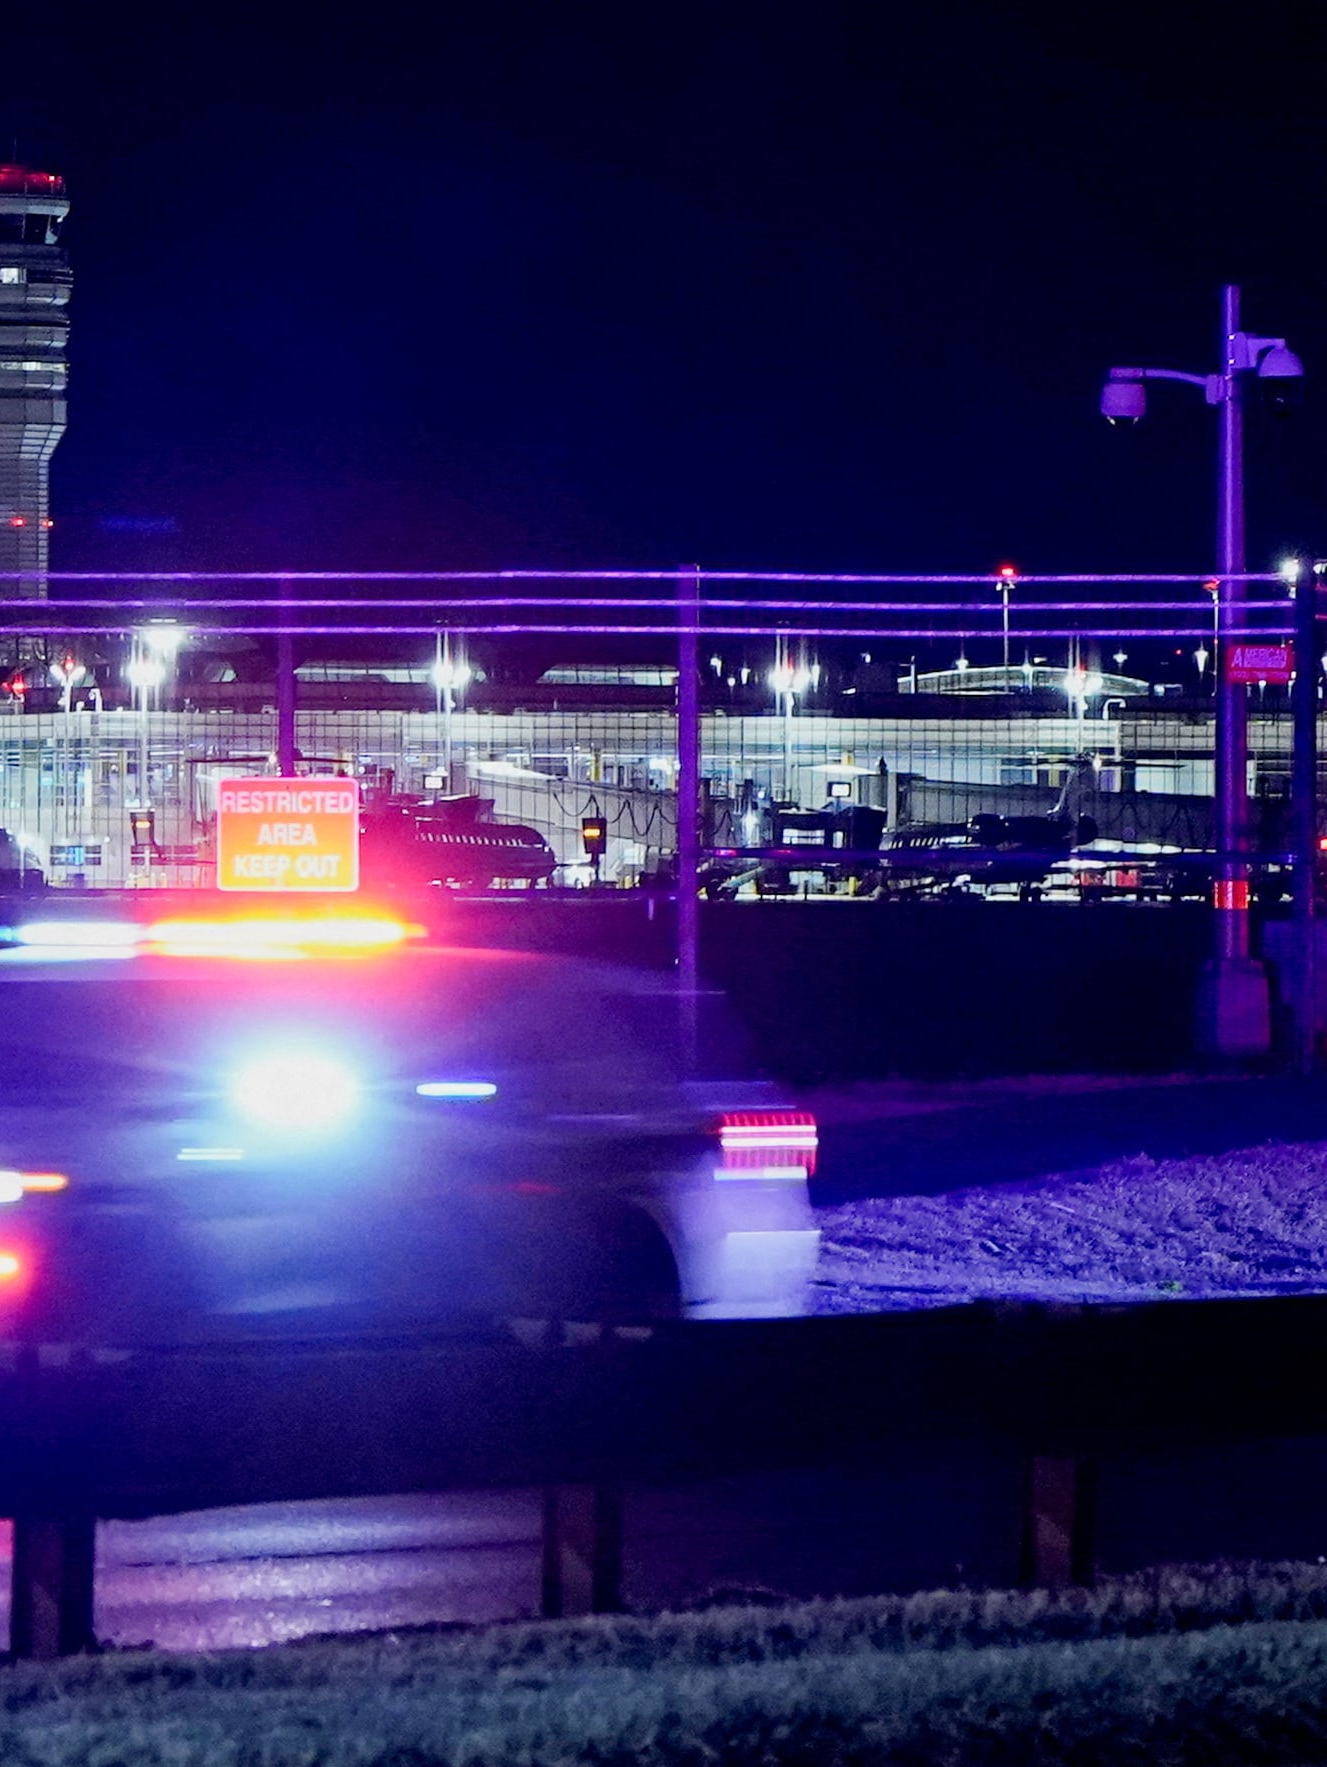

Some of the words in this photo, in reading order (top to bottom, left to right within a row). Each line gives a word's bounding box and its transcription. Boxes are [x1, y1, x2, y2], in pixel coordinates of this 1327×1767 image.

[222, 791, 354, 814] RESTRICTED
[257, 824, 316, 846] AREA
[234, 854, 291, 877] KEEP
[296, 854, 341, 878] OUT
